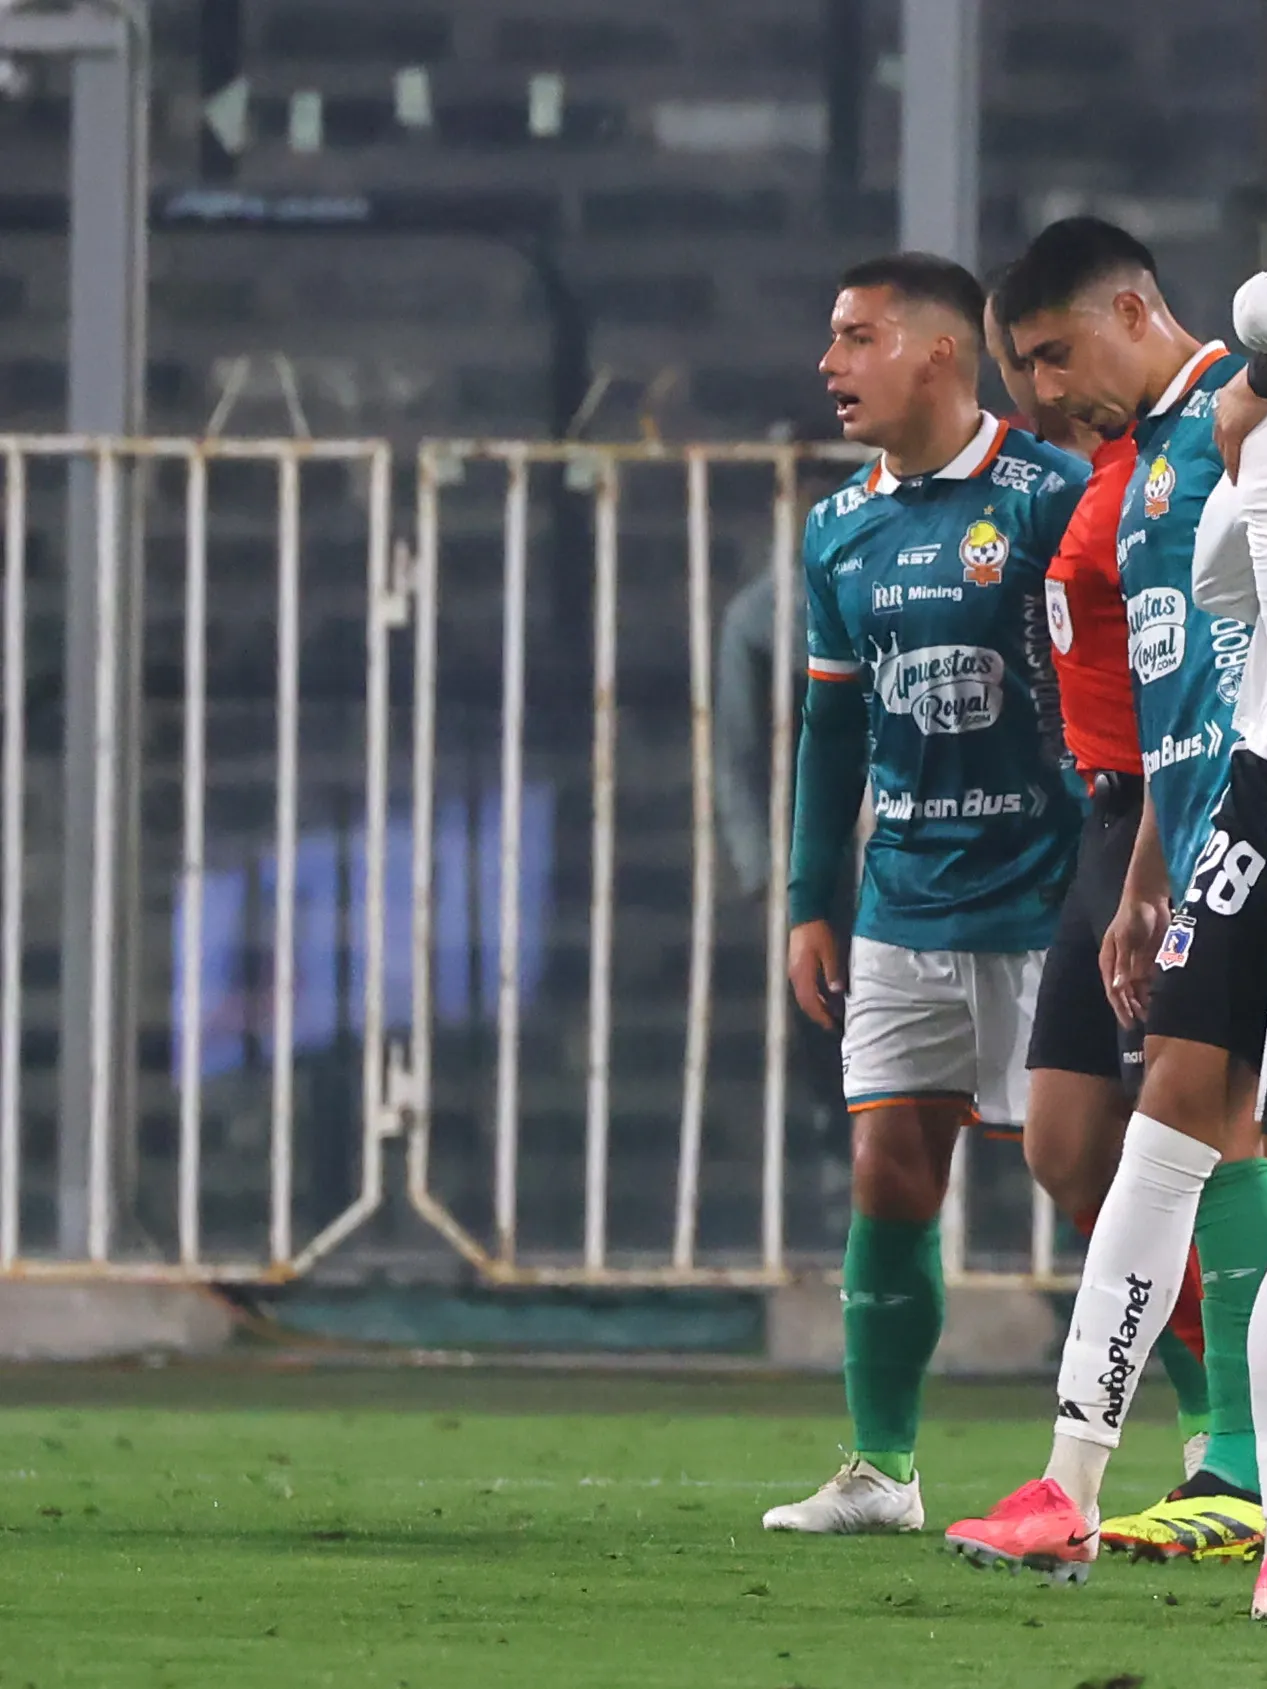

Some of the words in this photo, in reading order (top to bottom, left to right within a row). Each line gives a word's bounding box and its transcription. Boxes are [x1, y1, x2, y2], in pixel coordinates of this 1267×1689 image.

[992, 455, 1042, 481] TEC
[908, 586, 963, 602] Mining
[1139, 627, 1177, 673] oyal
[1210, 617, 1250, 670] ROD
[888, 649, 994, 700] Apuestas
[920, 685, 990, 730] Royal
[1186, 830, 1267, 917] 28
[1097, 1272, 1154, 1429] AutoPlanet
